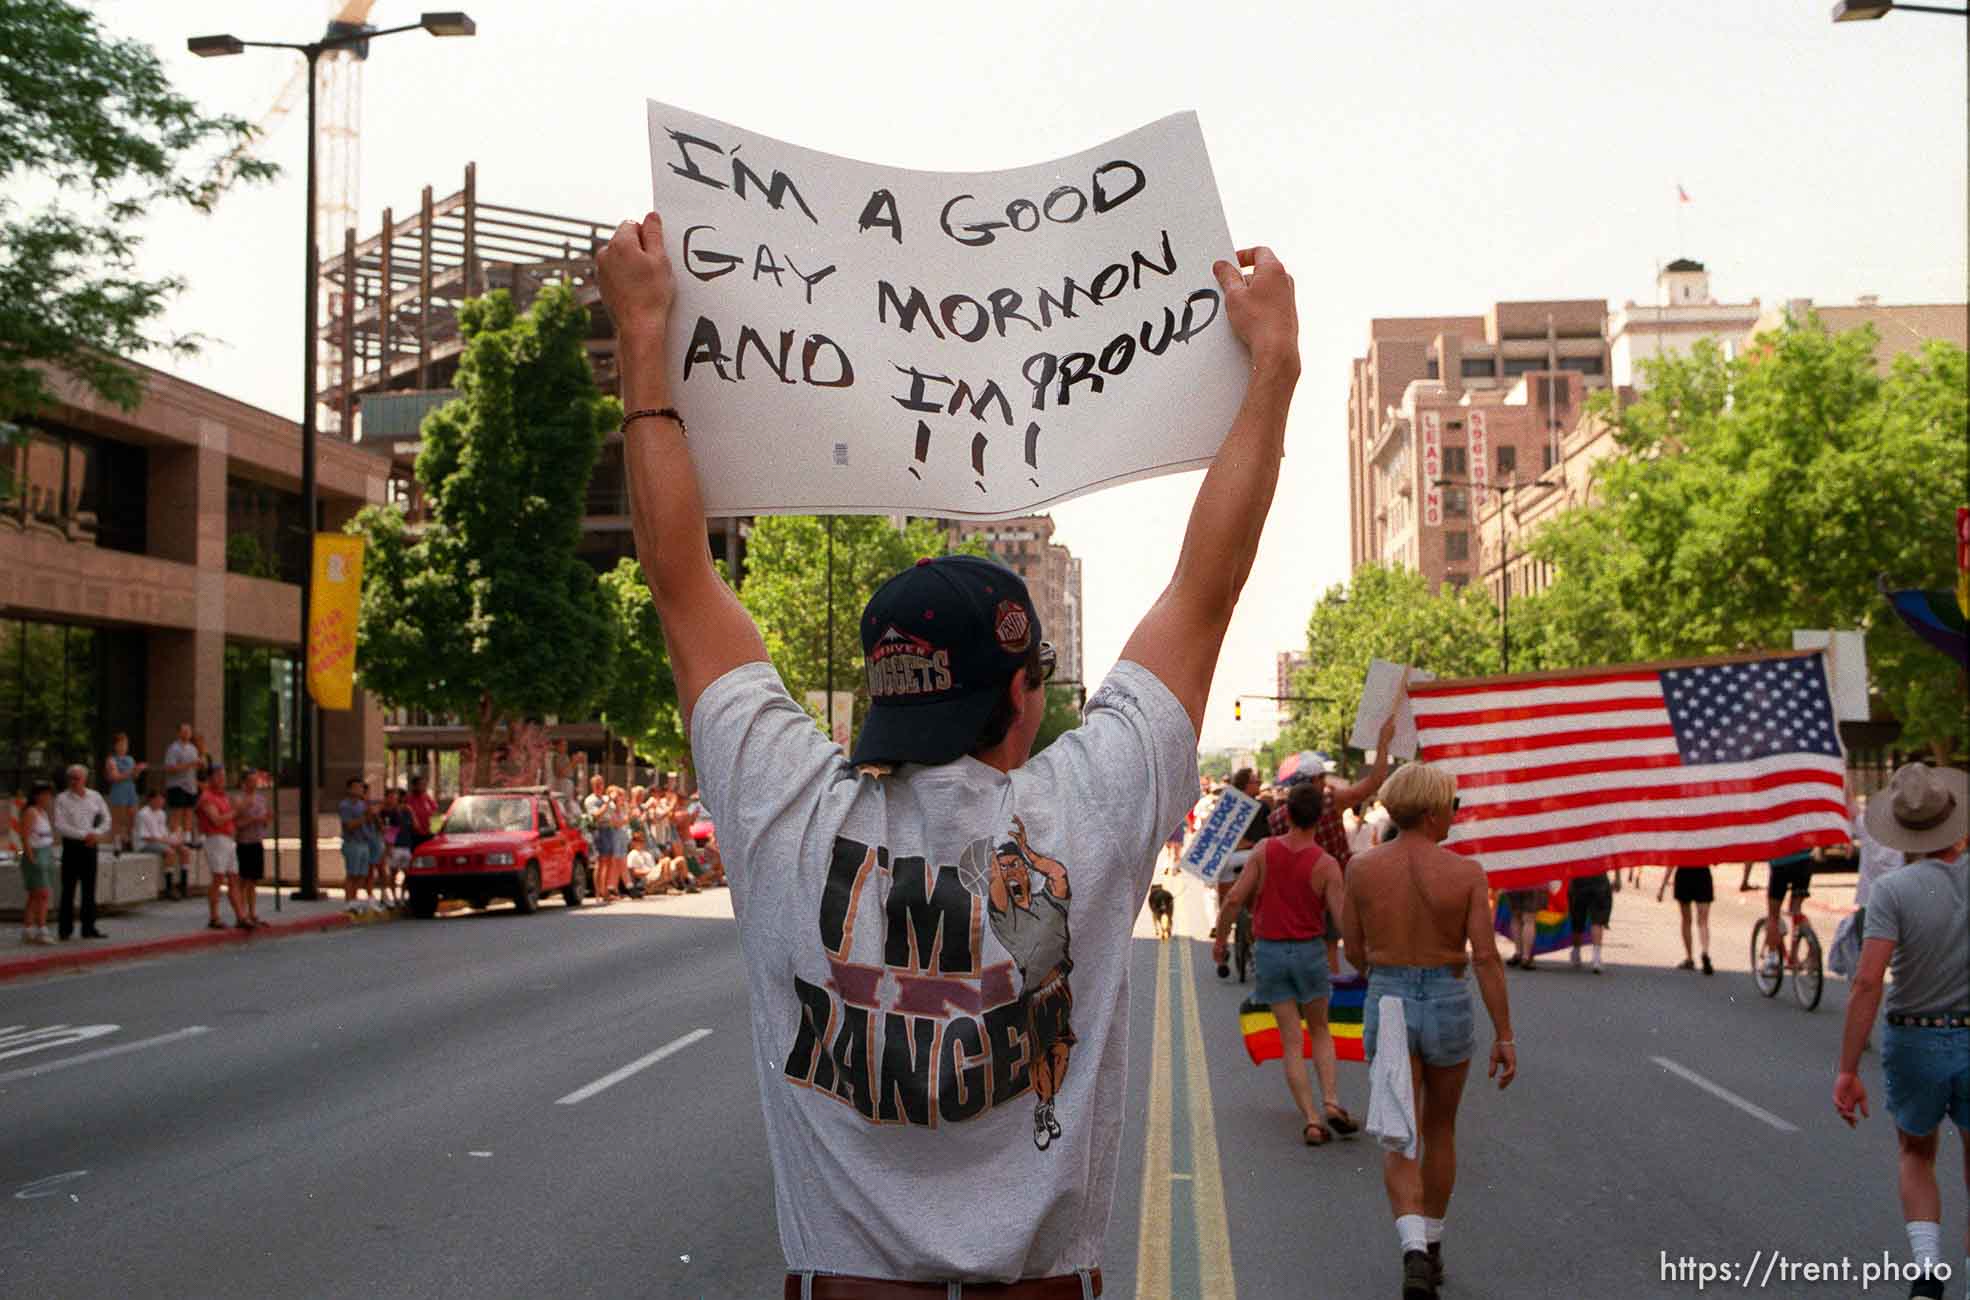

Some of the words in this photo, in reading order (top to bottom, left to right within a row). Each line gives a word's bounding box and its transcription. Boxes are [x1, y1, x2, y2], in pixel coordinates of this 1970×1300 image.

[665, 126, 819, 224] I'M
[858, 188, 902, 244] A
[940, 160, 1146, 246] GOOD
[683, 225, 836, 304] GAY
[878, 230, 1177, 342] MORMON
[682, 315, 855, 387] AND
[1021, 288, 1221, 411] PROUD
[1425, 416, 1438, 522] LEASNG
[865, 648, 952, 697] NUGGETS
[1188, 792, 1238, 865] KNOWLEDGE
[1202, 800, 1253, 877] PROTECTION
[819, 835, 982, 979] I'M
